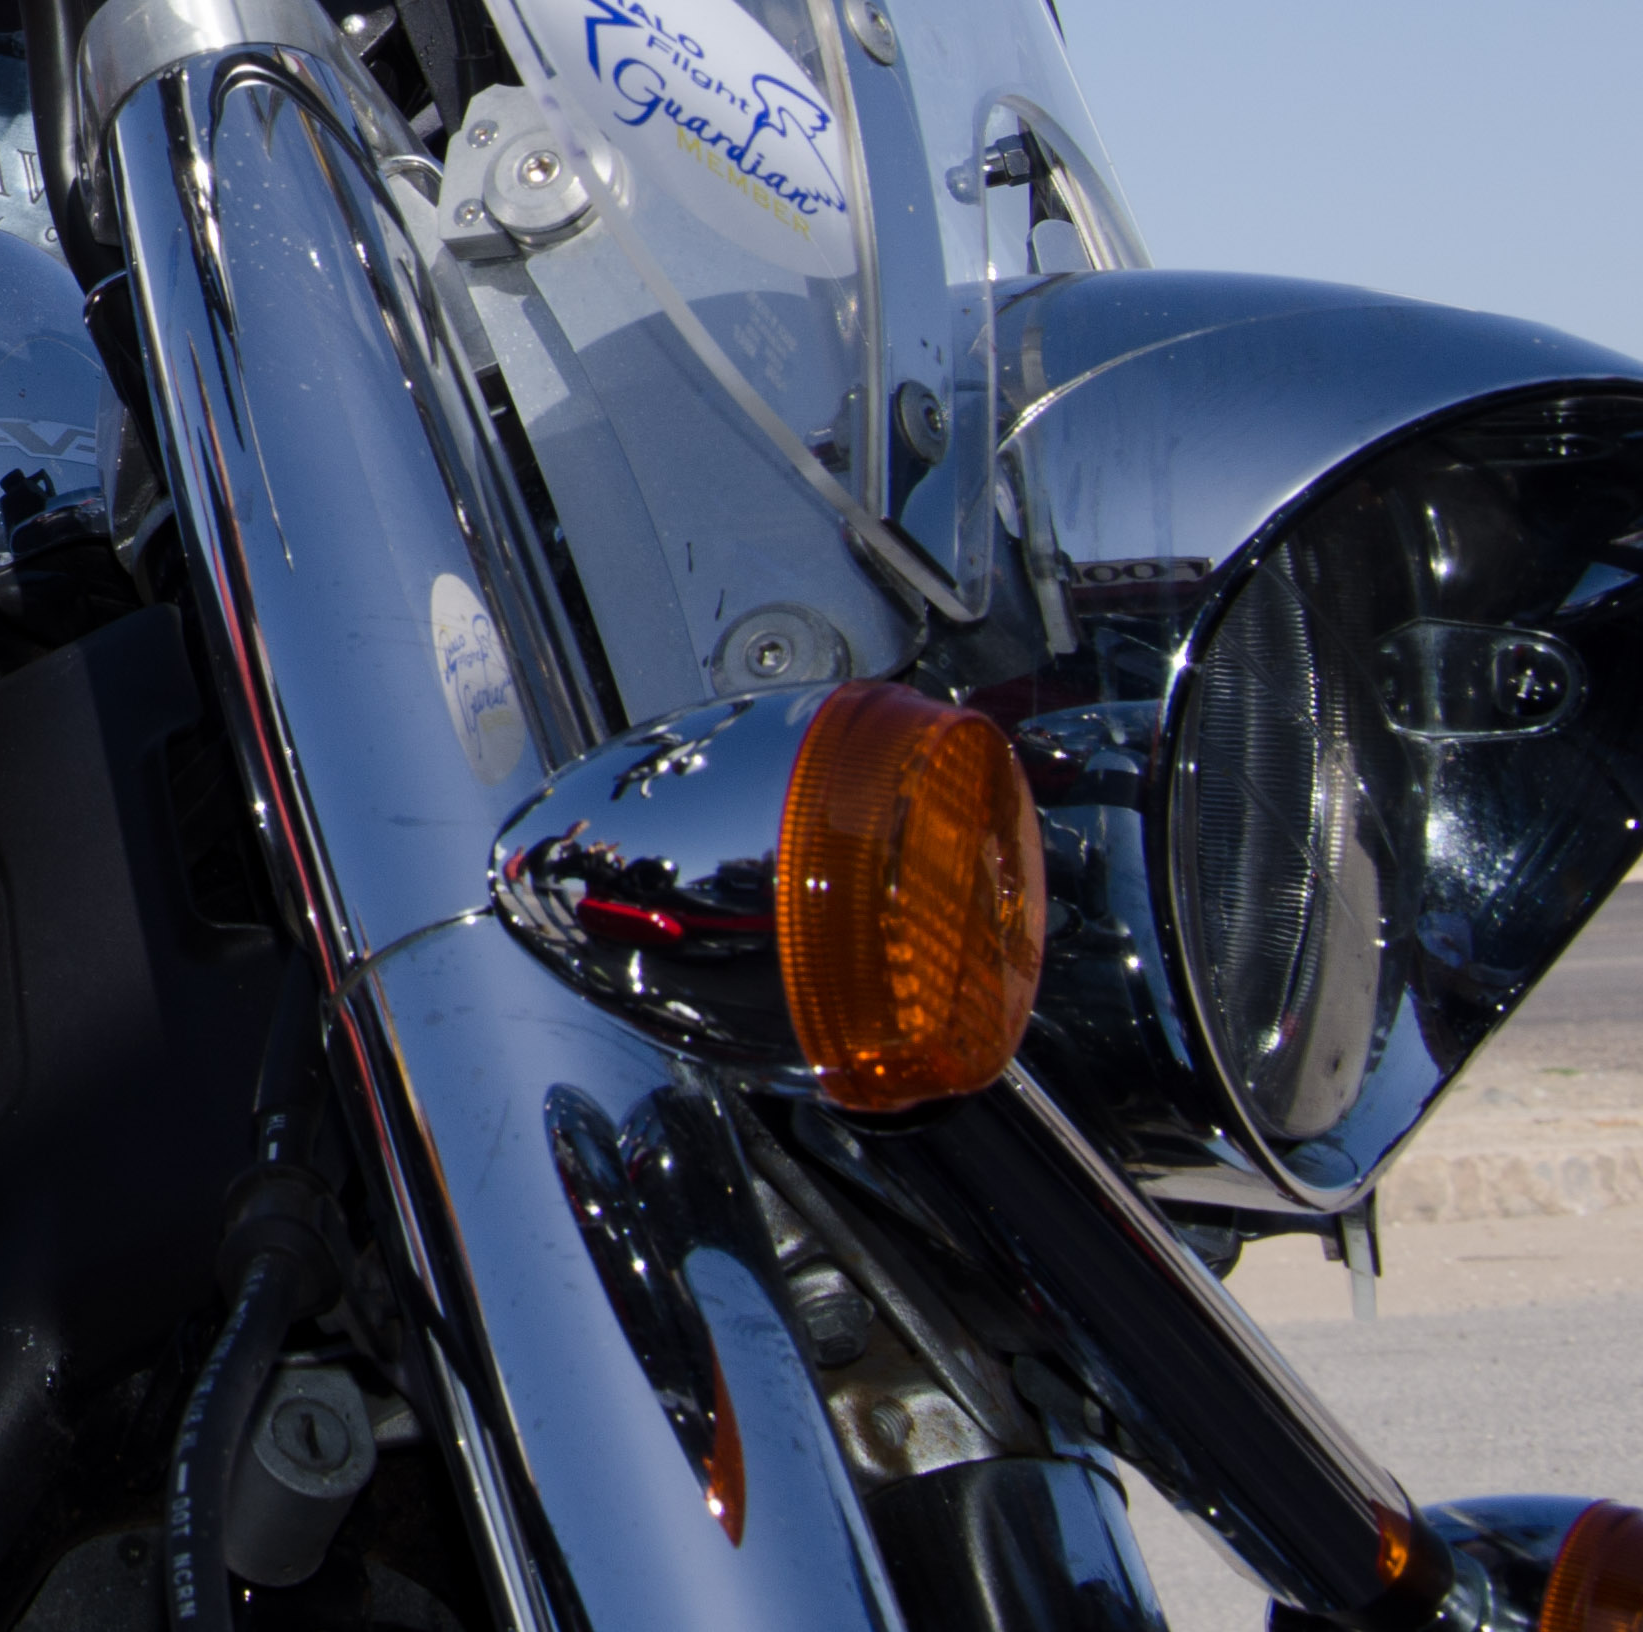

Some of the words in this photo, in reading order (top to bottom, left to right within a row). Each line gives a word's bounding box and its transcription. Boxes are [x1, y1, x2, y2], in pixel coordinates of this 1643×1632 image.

[646, 34, 750, 115] Flight
[612, 57, 819, 216] Guardian
[676, 126, 812, 243] MEMBER
